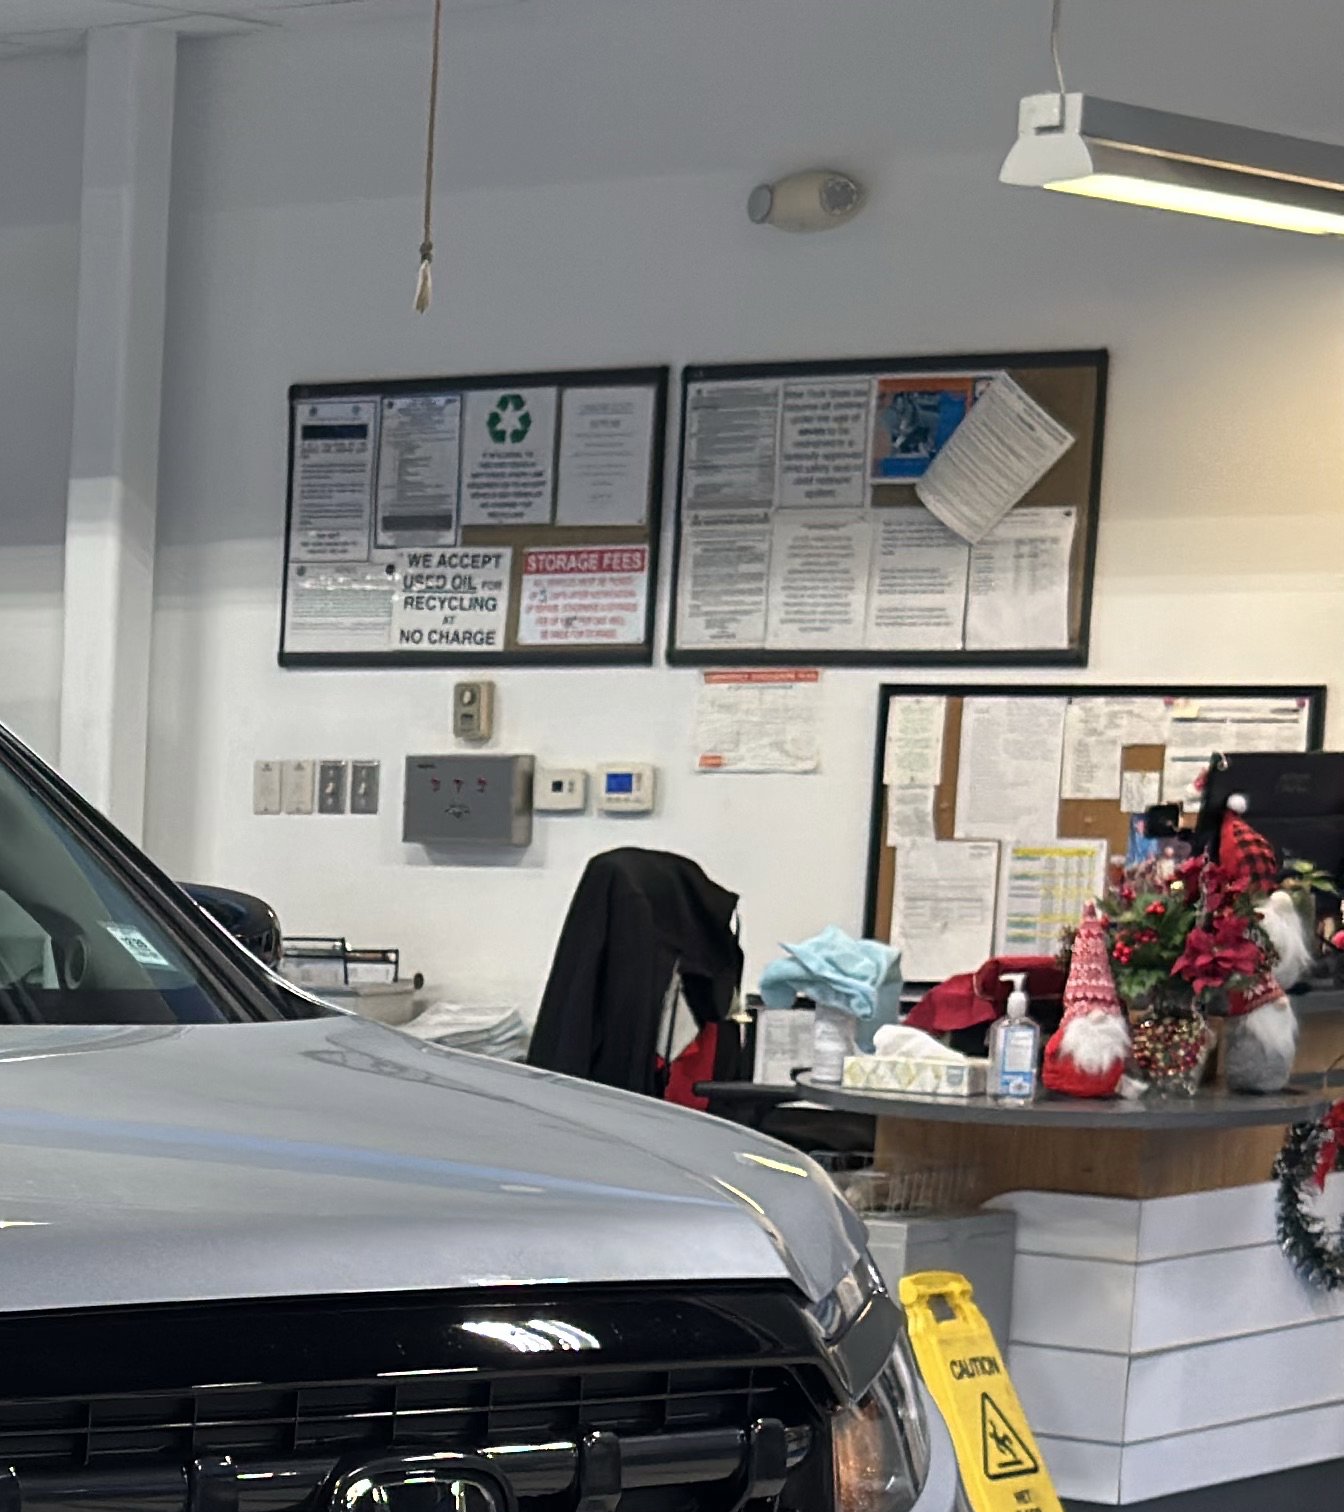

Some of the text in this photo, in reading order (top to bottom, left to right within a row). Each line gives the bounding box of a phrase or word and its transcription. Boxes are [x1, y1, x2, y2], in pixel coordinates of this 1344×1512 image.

[407, 553, 503, 569] WE ACCEPT
[527, 551, 642, 571] STORAGE FEES
[403, 574, 447, 590] USED
[452, 574, 477, 591] OIL
[404, 595, 497, 612] RECYCLING
[399, 629, 496, 646] NO CHARGE
[949, 1355, 1001, 1380] CAUTION
